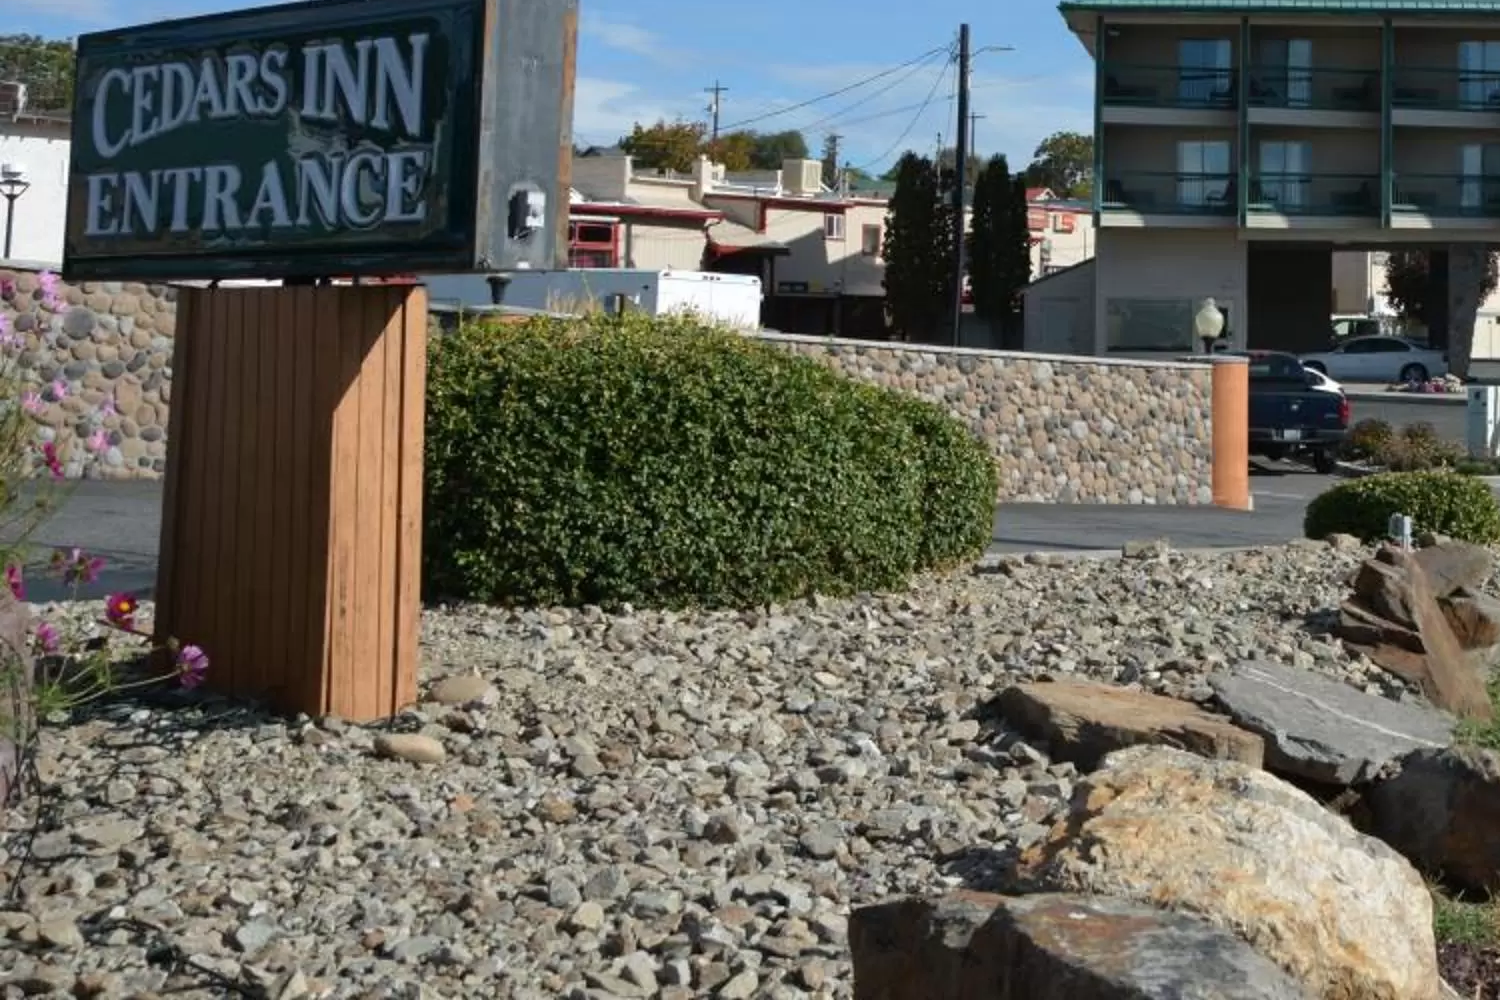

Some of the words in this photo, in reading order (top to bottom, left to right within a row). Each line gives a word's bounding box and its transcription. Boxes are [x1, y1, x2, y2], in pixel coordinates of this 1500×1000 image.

[92, 49, 288, 158] CEDARS
[301, 33, 430, 137] INN
[84, 150, 427, 236] ENTRANCE
